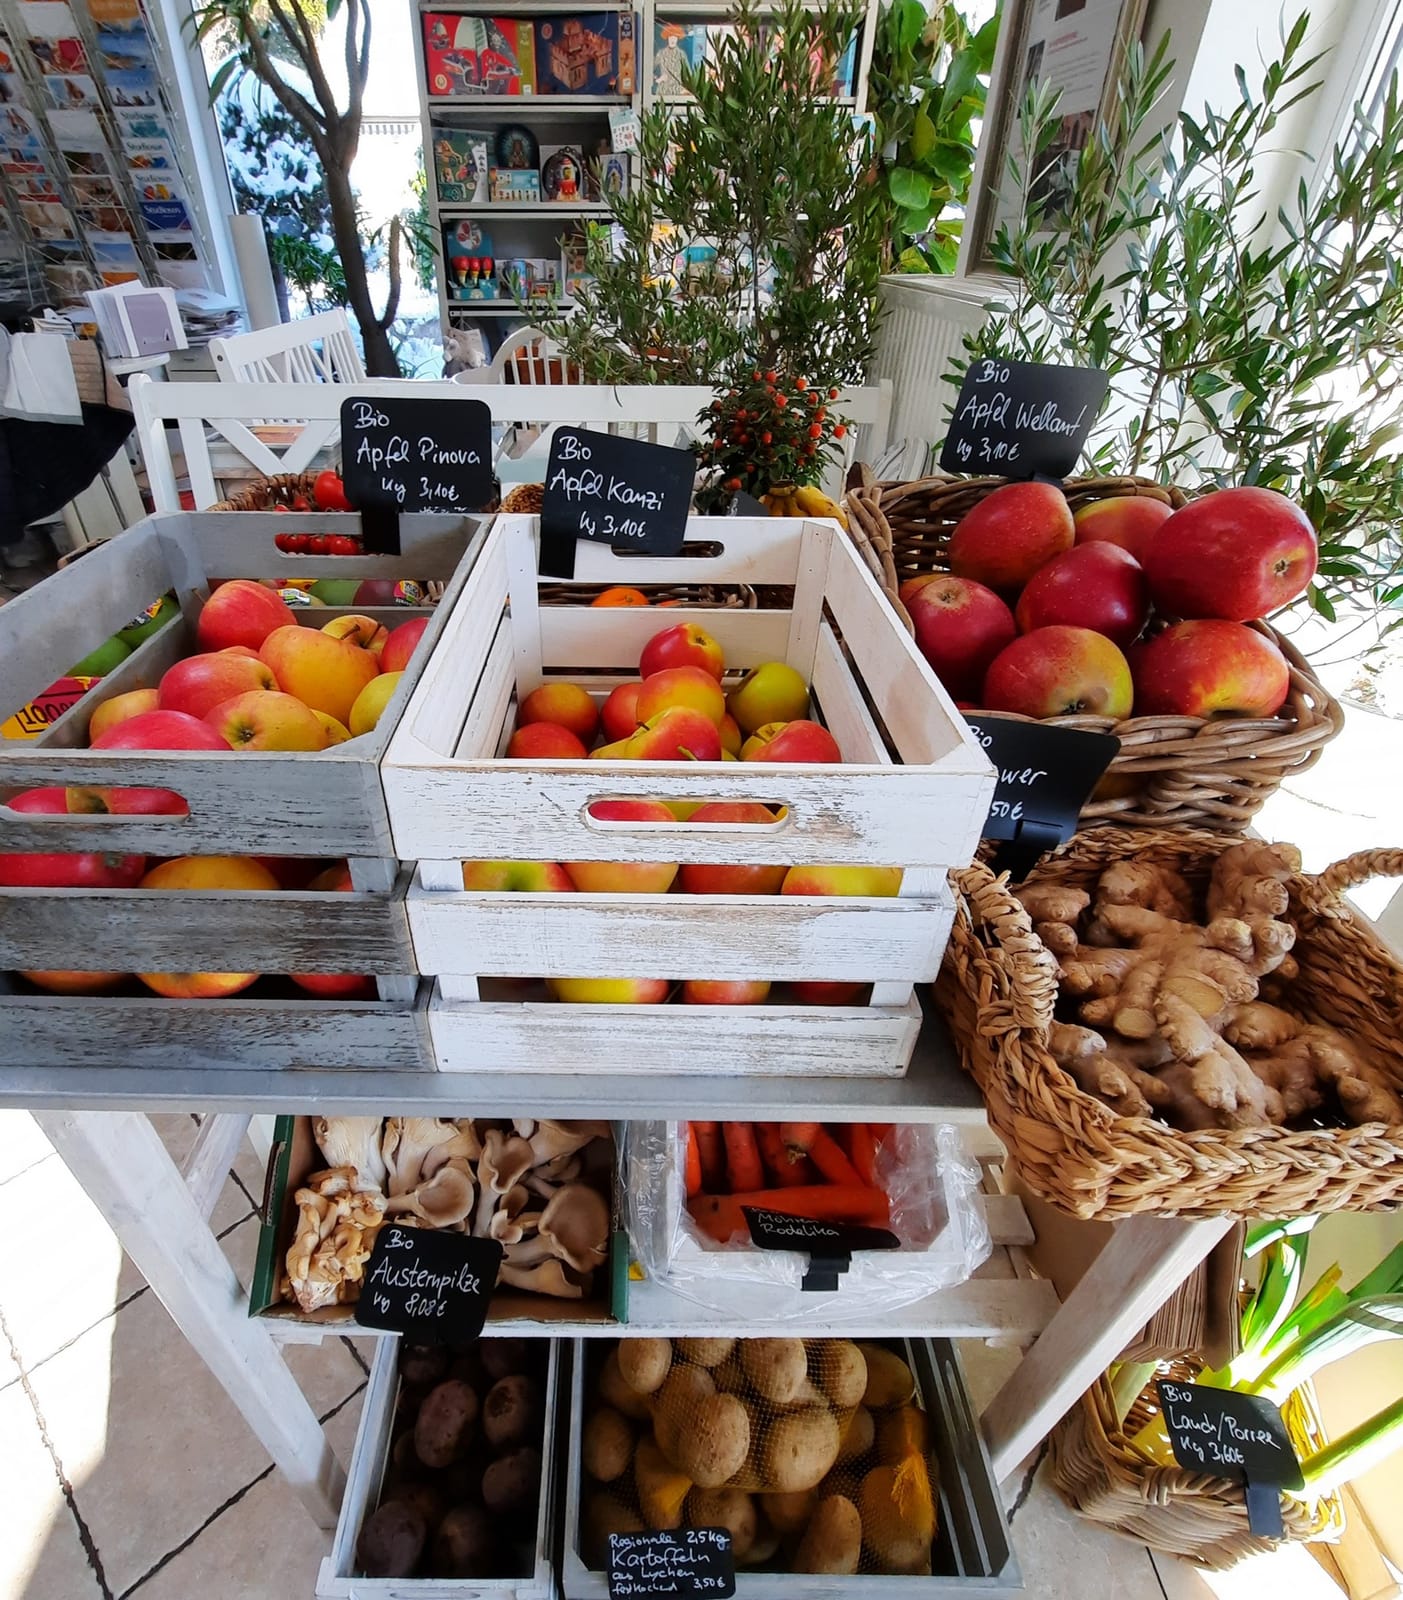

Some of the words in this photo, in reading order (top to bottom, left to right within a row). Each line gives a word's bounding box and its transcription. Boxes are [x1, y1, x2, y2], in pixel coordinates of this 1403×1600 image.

[144, 205, 182, 215] Studiosus
[975, 360, 1010, 383] Bio
[352, 402, 390, 429] Bio
[960, 392, 1011, 429] Apfel
[1015, 401, 1088, 437] Wellant
[356, 436, 410, 472] Apfel
[418, 436, 481, 465] Pinova
[557, 436, 592, 461] Bio
[979, 437, 1020, 463] 3,10€
[419, 477, 460, 502] 3,10€
[549, 468, 602, 499] Apfel
[607, 475, 665, 511] Kanzi
[602, 515, 647, 537] 3,10€
[1000, 768, 1048, 786] wer
[991, 800, 1024, 820] 50€
[385, 1229, 414, 1249] Bio
[760, 1223, 840, 1236] Rodelika
[370, 1256, 480, 1299] Austernpilze
[1162, 1384, 1192, 1403] Bio
[609, 1533, 677, 1548] Regionale
[612, 1547, 710, 1567] Kartoffeln
[641, 1567, 695, 1581] Lychen
